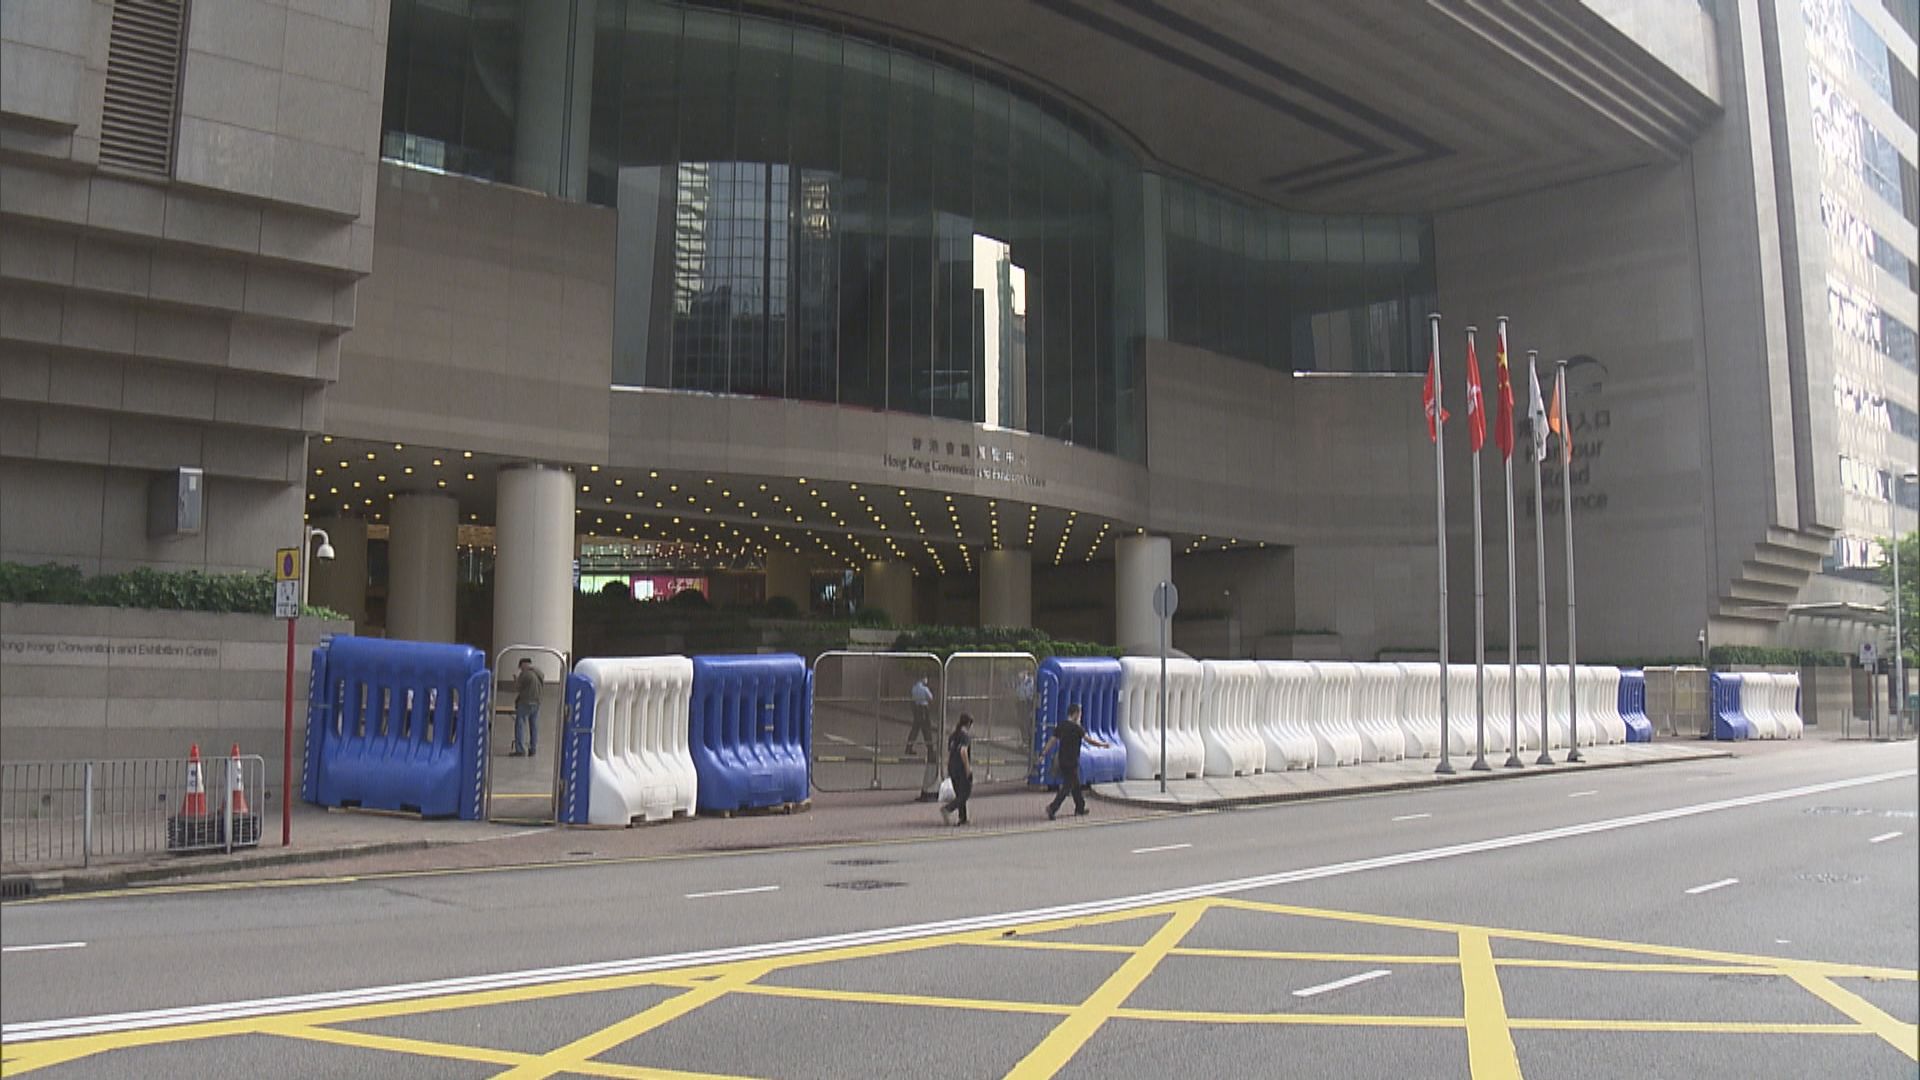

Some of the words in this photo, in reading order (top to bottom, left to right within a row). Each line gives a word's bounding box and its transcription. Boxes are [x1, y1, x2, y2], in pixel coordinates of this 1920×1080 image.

[883, 453, 907, 471] Hong
[908, 456, 931, 473] Kong
[26, 641, 56, 654] Kong
[116, 644, 137, 655] and
